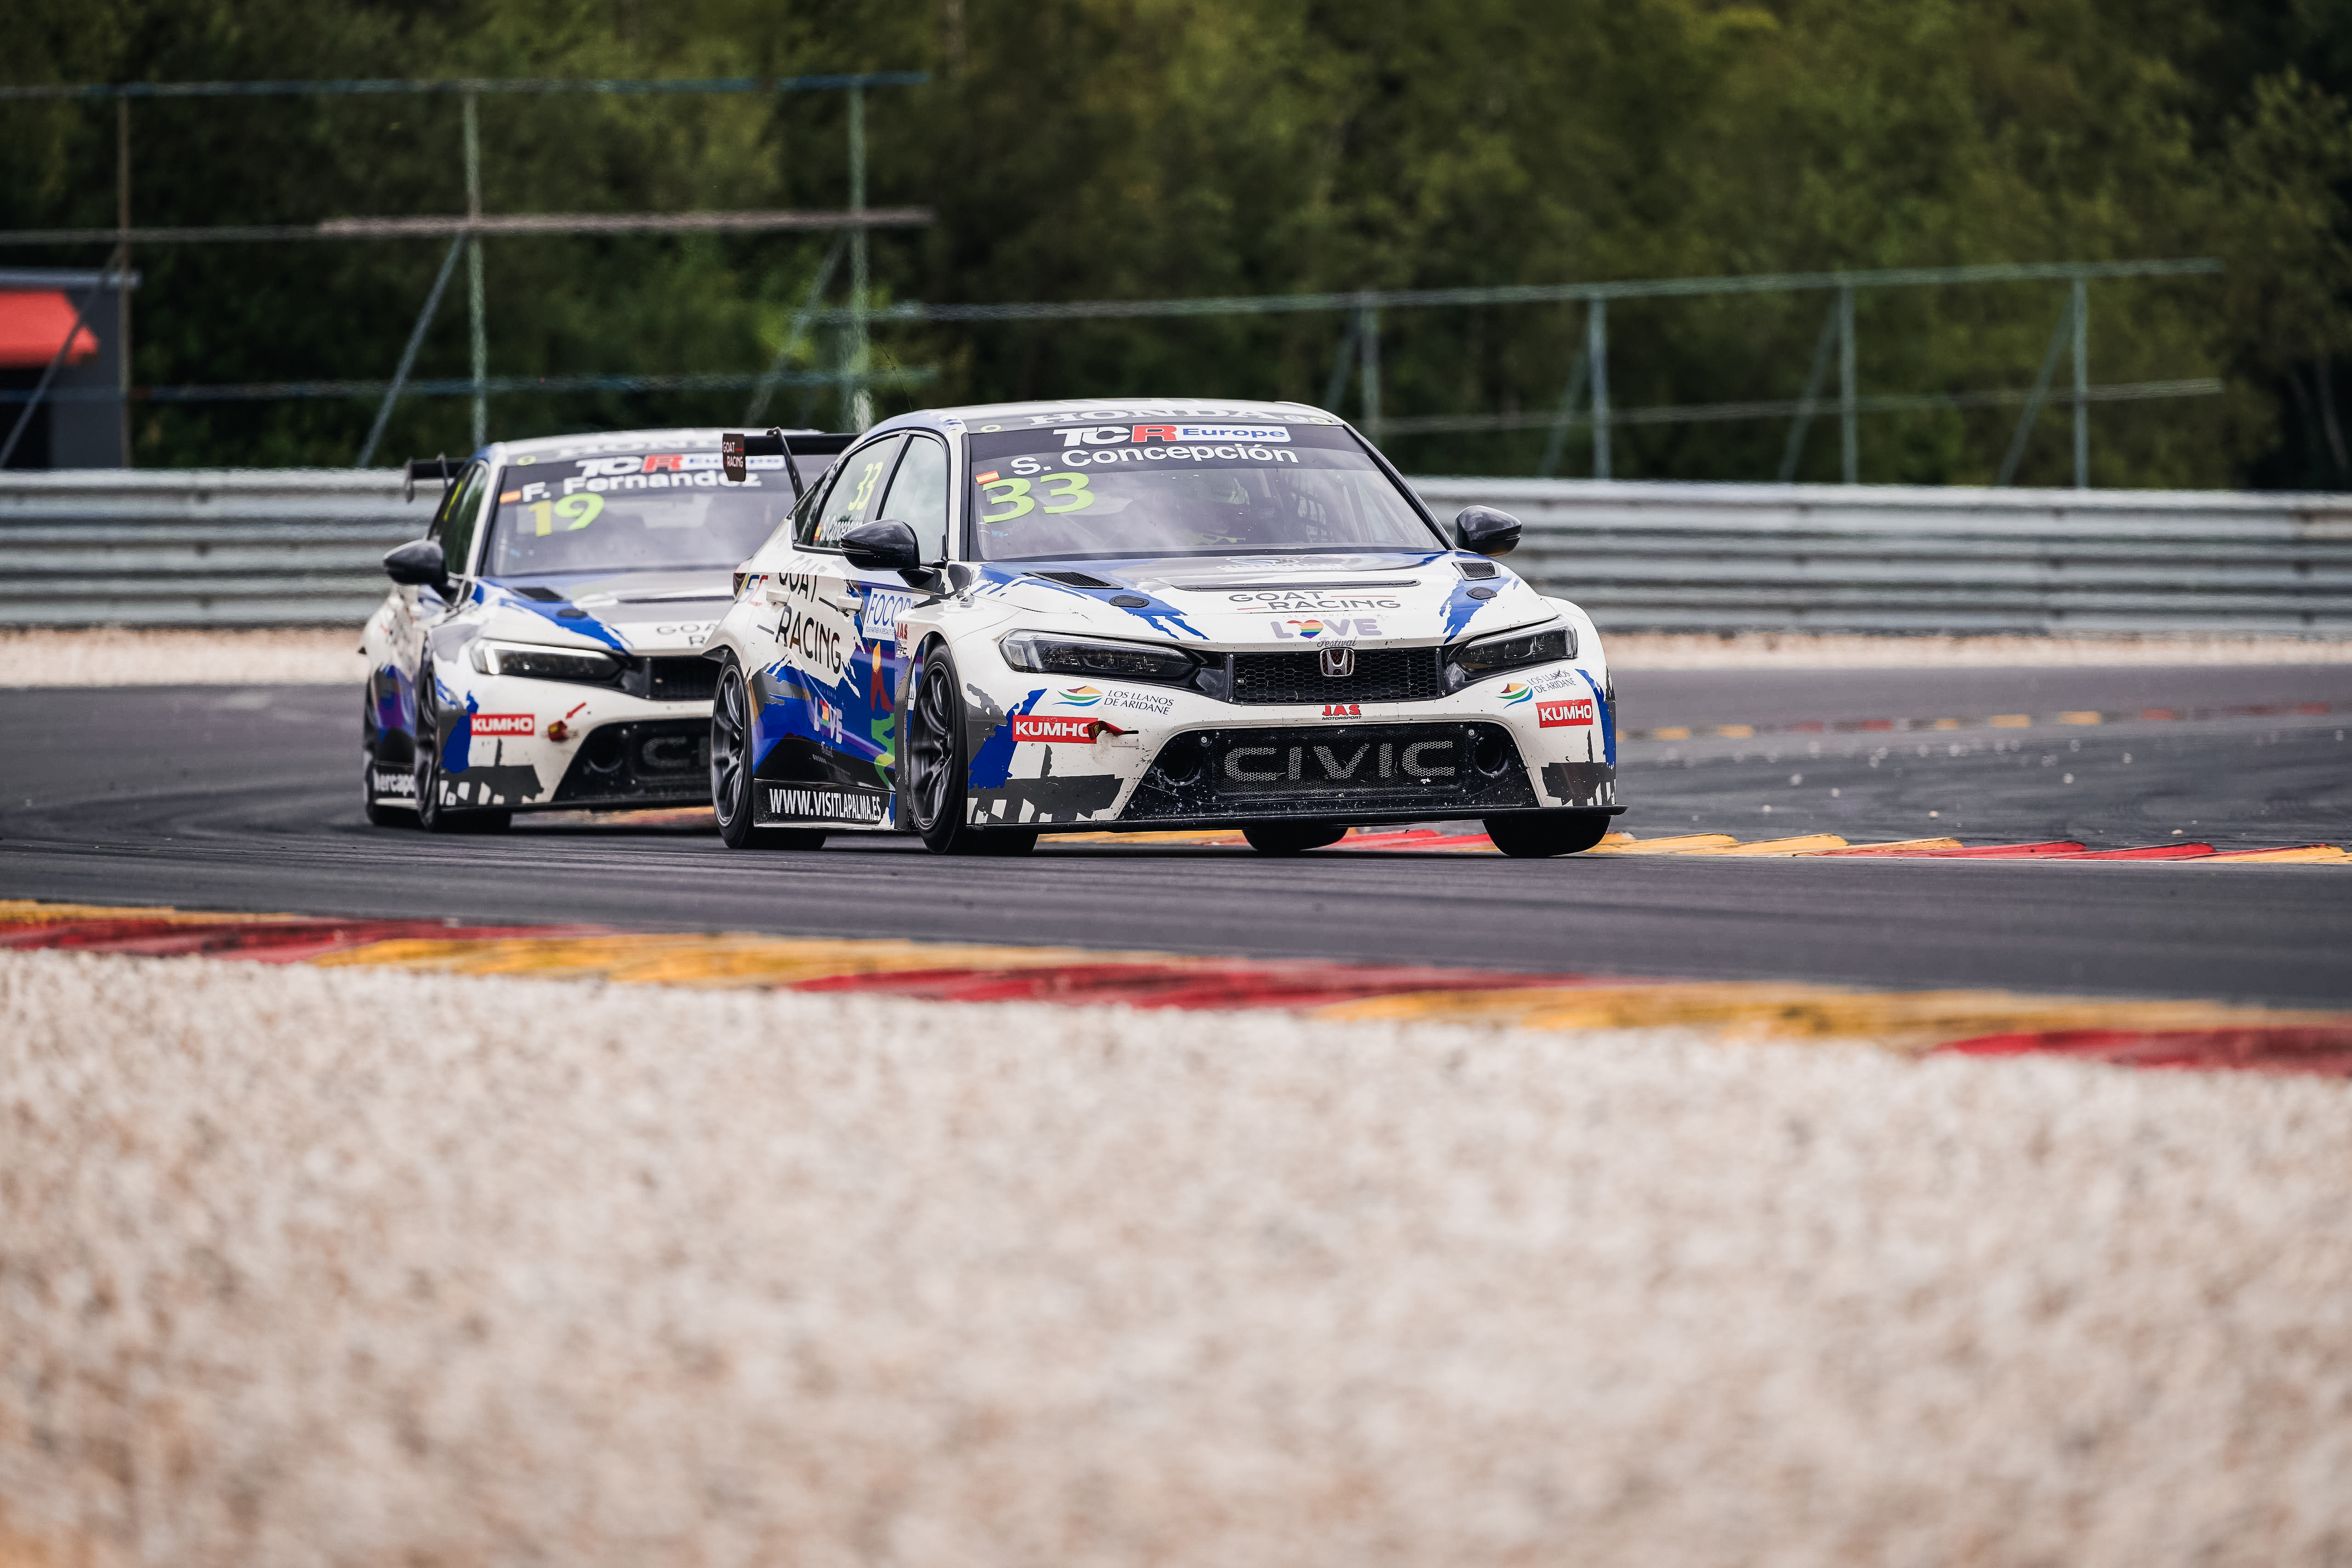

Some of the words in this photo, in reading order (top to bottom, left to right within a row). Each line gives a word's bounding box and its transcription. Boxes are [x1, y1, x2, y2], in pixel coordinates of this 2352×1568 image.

[1029, 410, 1284, 425] HONDA
[1053, 424, 1179, 447] TCR
[1183, 428, 1287, 439] Europe
[723, 442, 735, 453] GOAT
[575, 454, 684, 478] TCR
[727, 455, 743, 468] RACING
[1011, 456, 1052, 475] S.
[1061, 444, 1300, 467] Concepción
[522, 481, 551, 502] F.
[848, 462, 883, 511] 33
[982, 472, 1095, 523] 33
[528, 492, 605, 536] 19
[1228, 591, 1323, 602] GOAT
[1268, 600, 1401, 610] RACING
[775, 605, 841, 674] RACING
[1316, 636, 1357, 648] Festival
[1527, 676, 1544, 685] LOS
[1546, 678, 1577, 690] ARIDANE
[1104, 697, 1119, 706] DE
[1120, 699, 1171, 716] ARIDANE
[1108, 690, 1130, 699] LOS
[1131, 692, 1174, 706] LLANOS
[1322, 704, 1362, 716] JAS
[1540, 705, 1592, 722] KUMHO
[472, 717, 533, 732] KUMHO
[1224, 740, 1456, 781] CIVIC
[769, 788, 882, 821] WWW.VISITLAPALMA.ES
